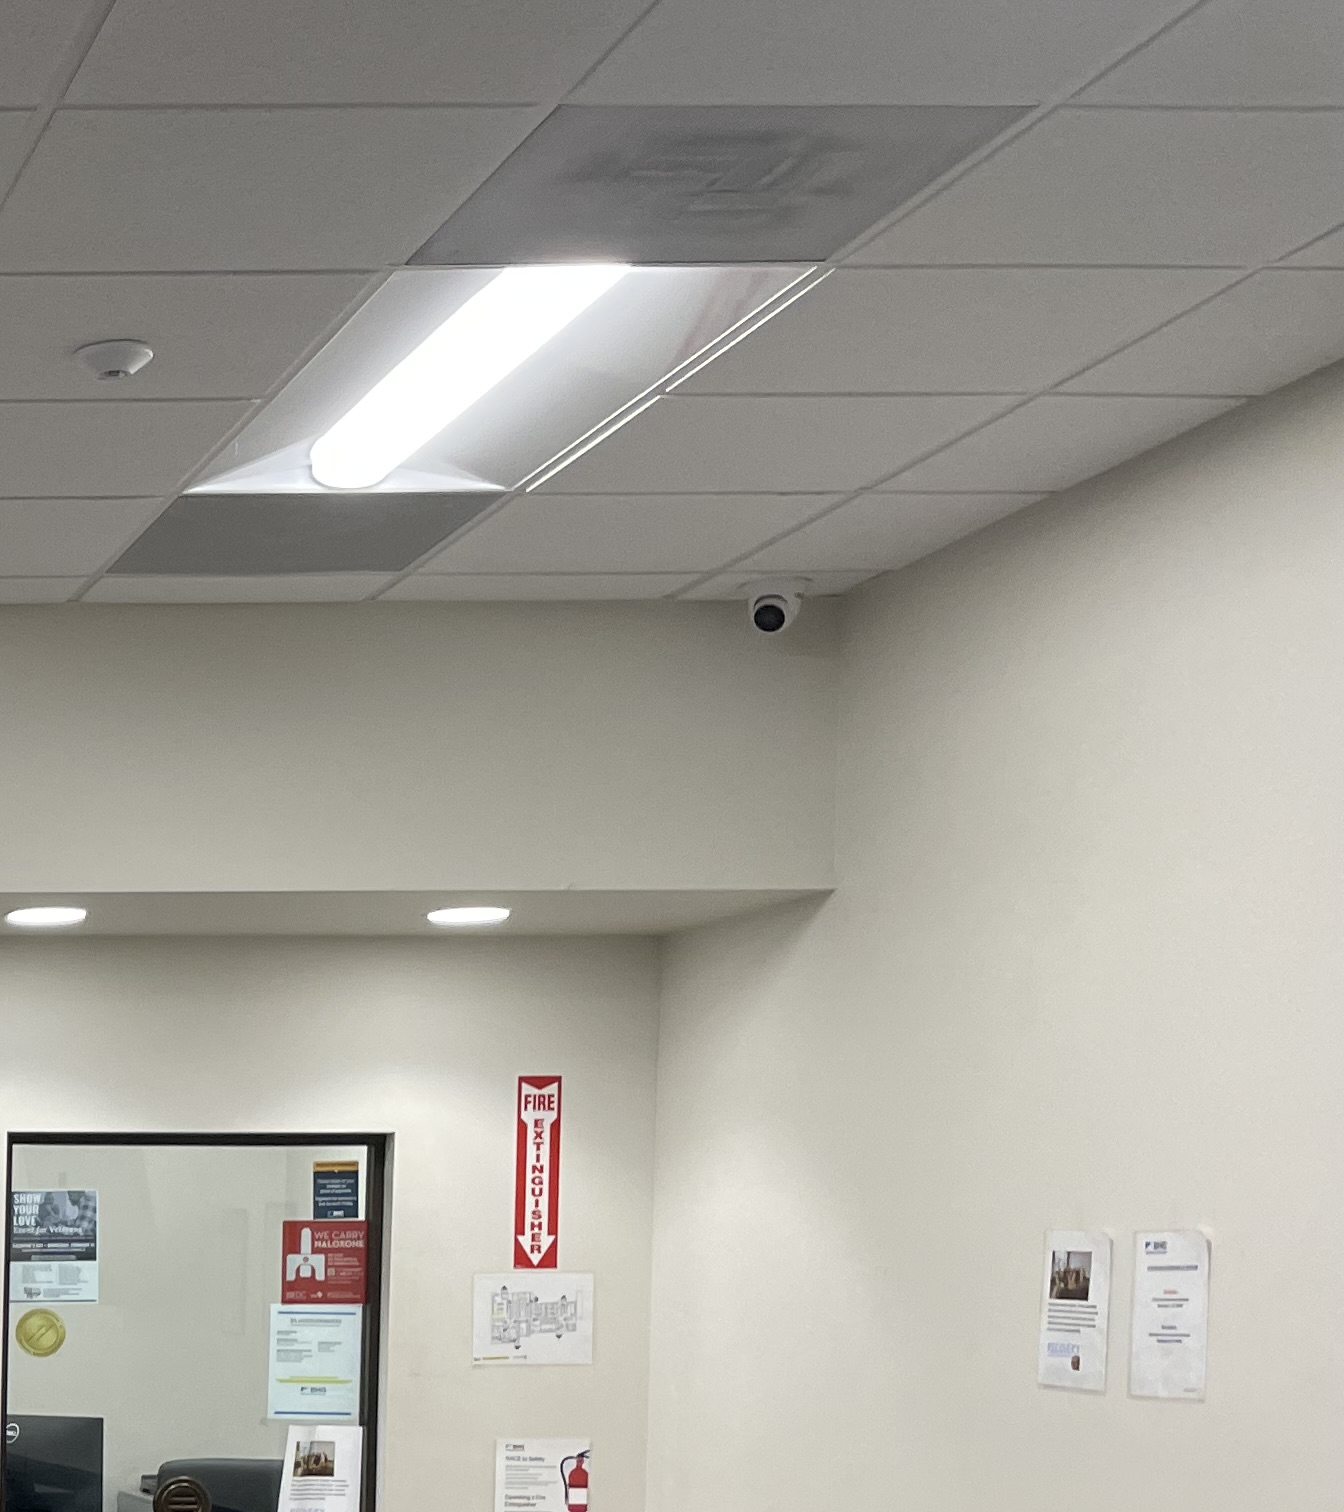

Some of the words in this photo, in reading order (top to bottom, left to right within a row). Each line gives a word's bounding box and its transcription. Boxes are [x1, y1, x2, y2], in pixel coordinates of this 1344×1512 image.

[524, 1093, 555, 1112] FIRE
[529, 1118, 544, 1254] EXTINGUISHER
[13, 1193, 42, 1204] SHOW
[13, 1205, 39, 1215] YOUR
[13, 1216, 37, 1226] LOVE
[314, 1231, 328, 1240] WE
[332, 1230, 365, 1240] CARRY
[314, 1239, 365, 1249] NALOXONE
